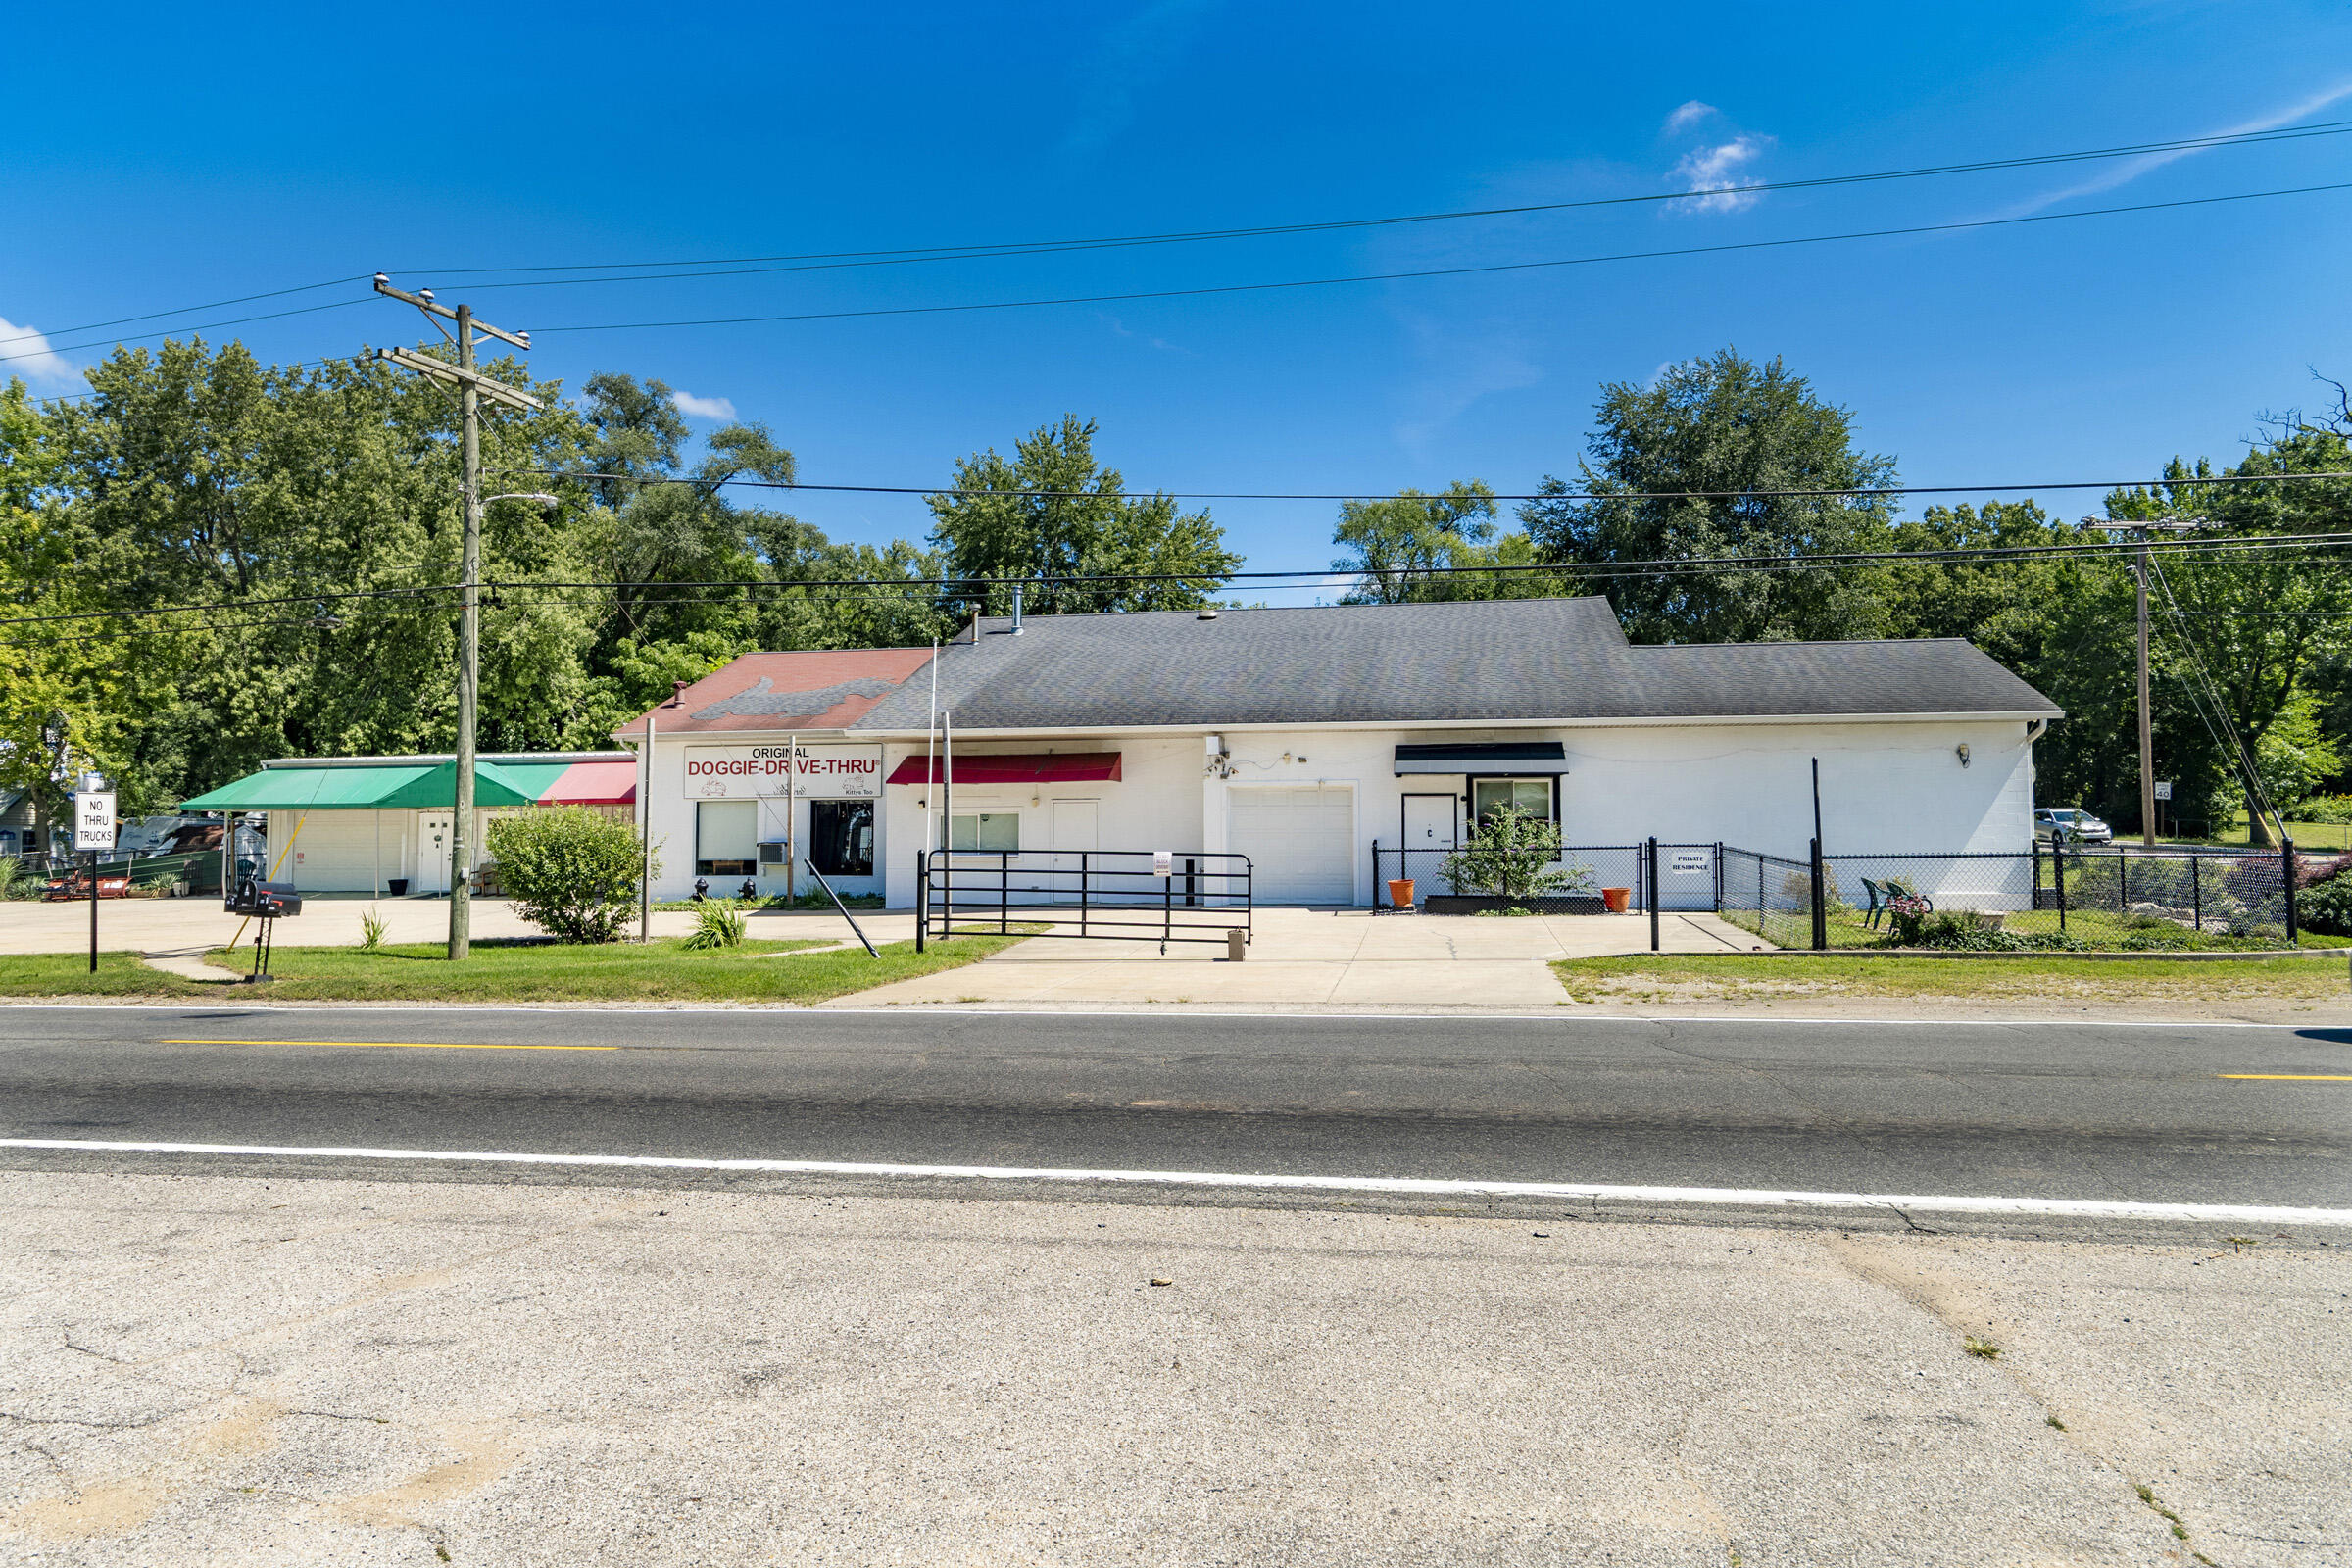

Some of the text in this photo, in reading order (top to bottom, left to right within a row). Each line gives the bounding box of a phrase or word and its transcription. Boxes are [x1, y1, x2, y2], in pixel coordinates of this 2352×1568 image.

[688, 759, 875, 776] DOGGIE-DRVE-THRU
[89, 800, 103, 811] NO
[84, 814, 109, 826] THRU
[79, 830, 112, 842] TRUCKS
